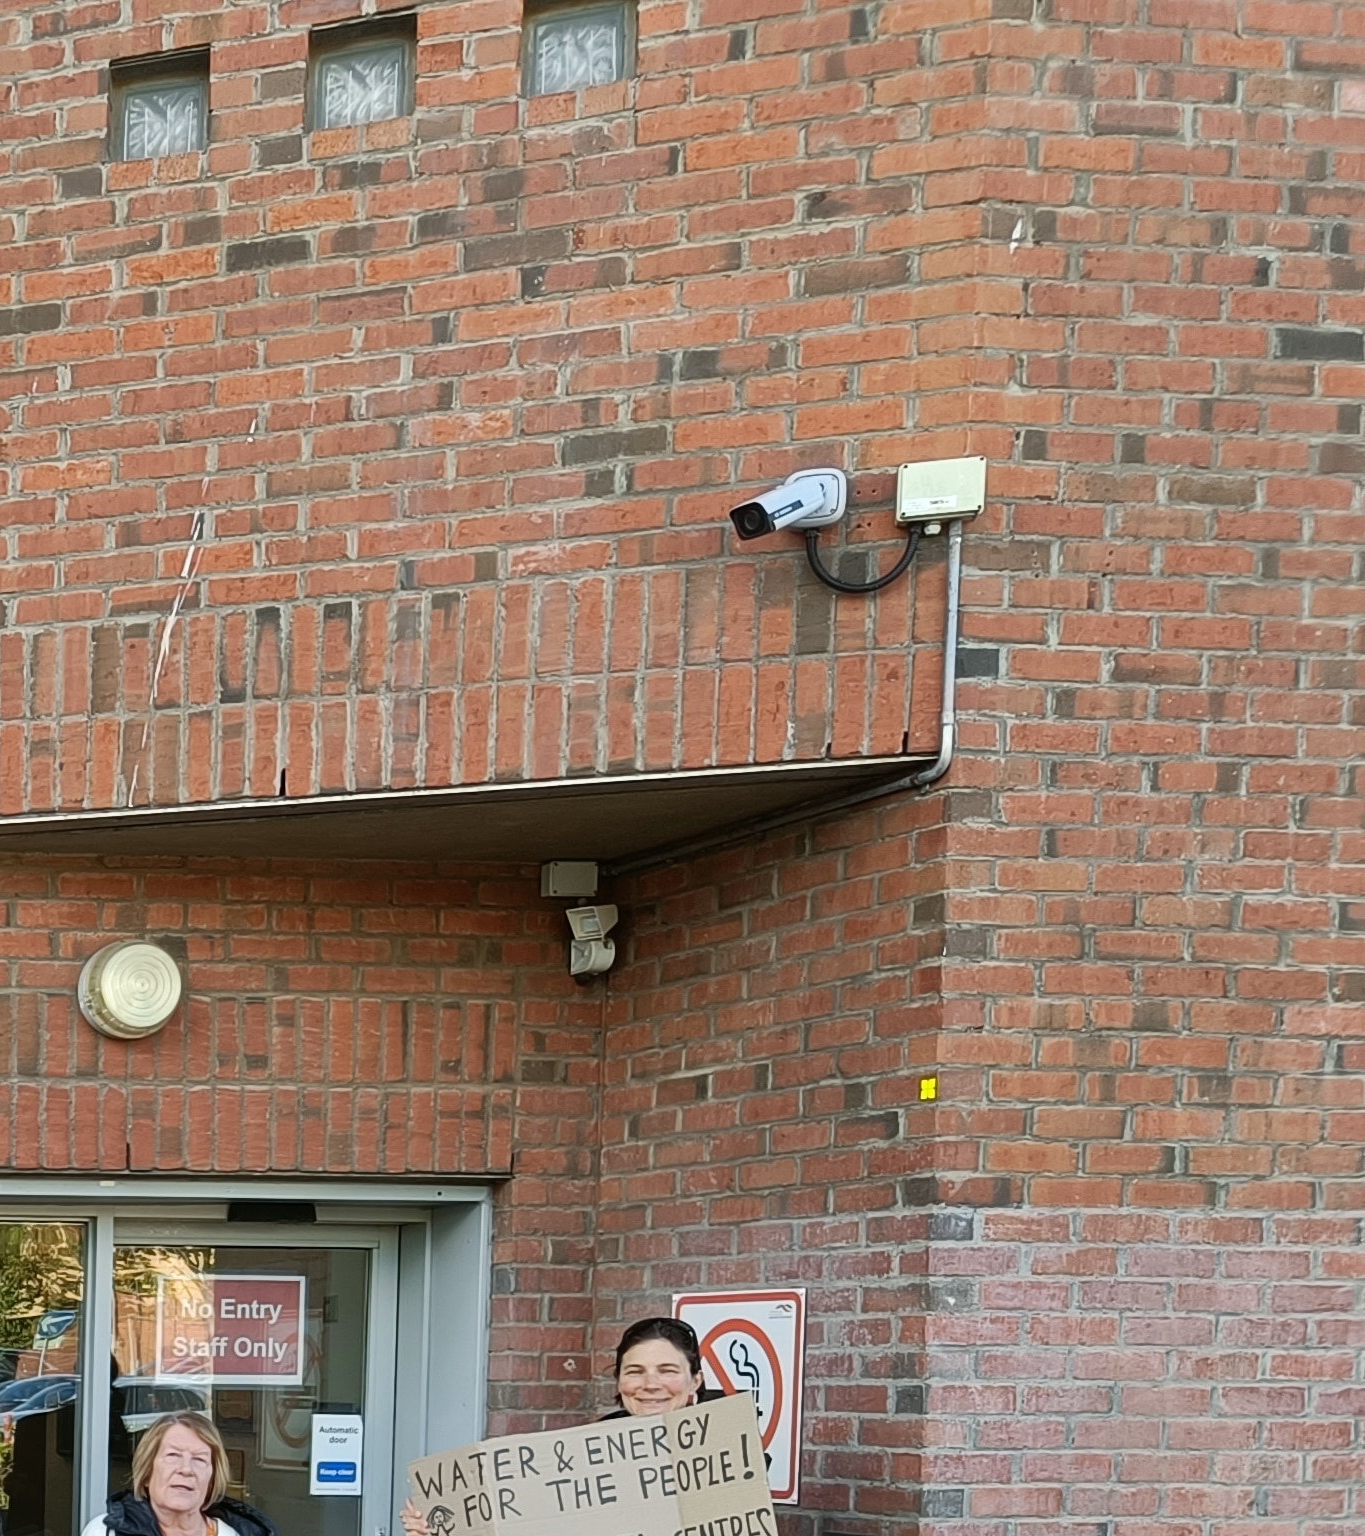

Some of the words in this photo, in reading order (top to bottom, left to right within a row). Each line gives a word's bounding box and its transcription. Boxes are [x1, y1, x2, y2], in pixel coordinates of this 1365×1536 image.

[181, 1299, 213, 1318] No
[220, 1298, 282, 1325] Entry
[172, 1336, 229, 1357] Staff
[234, 1337, 289, 1363] Only
[319, 1426, 359, 1434] Automatic
[415, 1447, 540, 1499] WATER
[556, 1441, 575, 1474] &
[585, 1413, 710, 1466] ENERGY
[464, 1488, 522, 1528] FOR
[545, 1473, 618, 1513] THE
[639, 1433, 755, 1500] PEOPLE!
